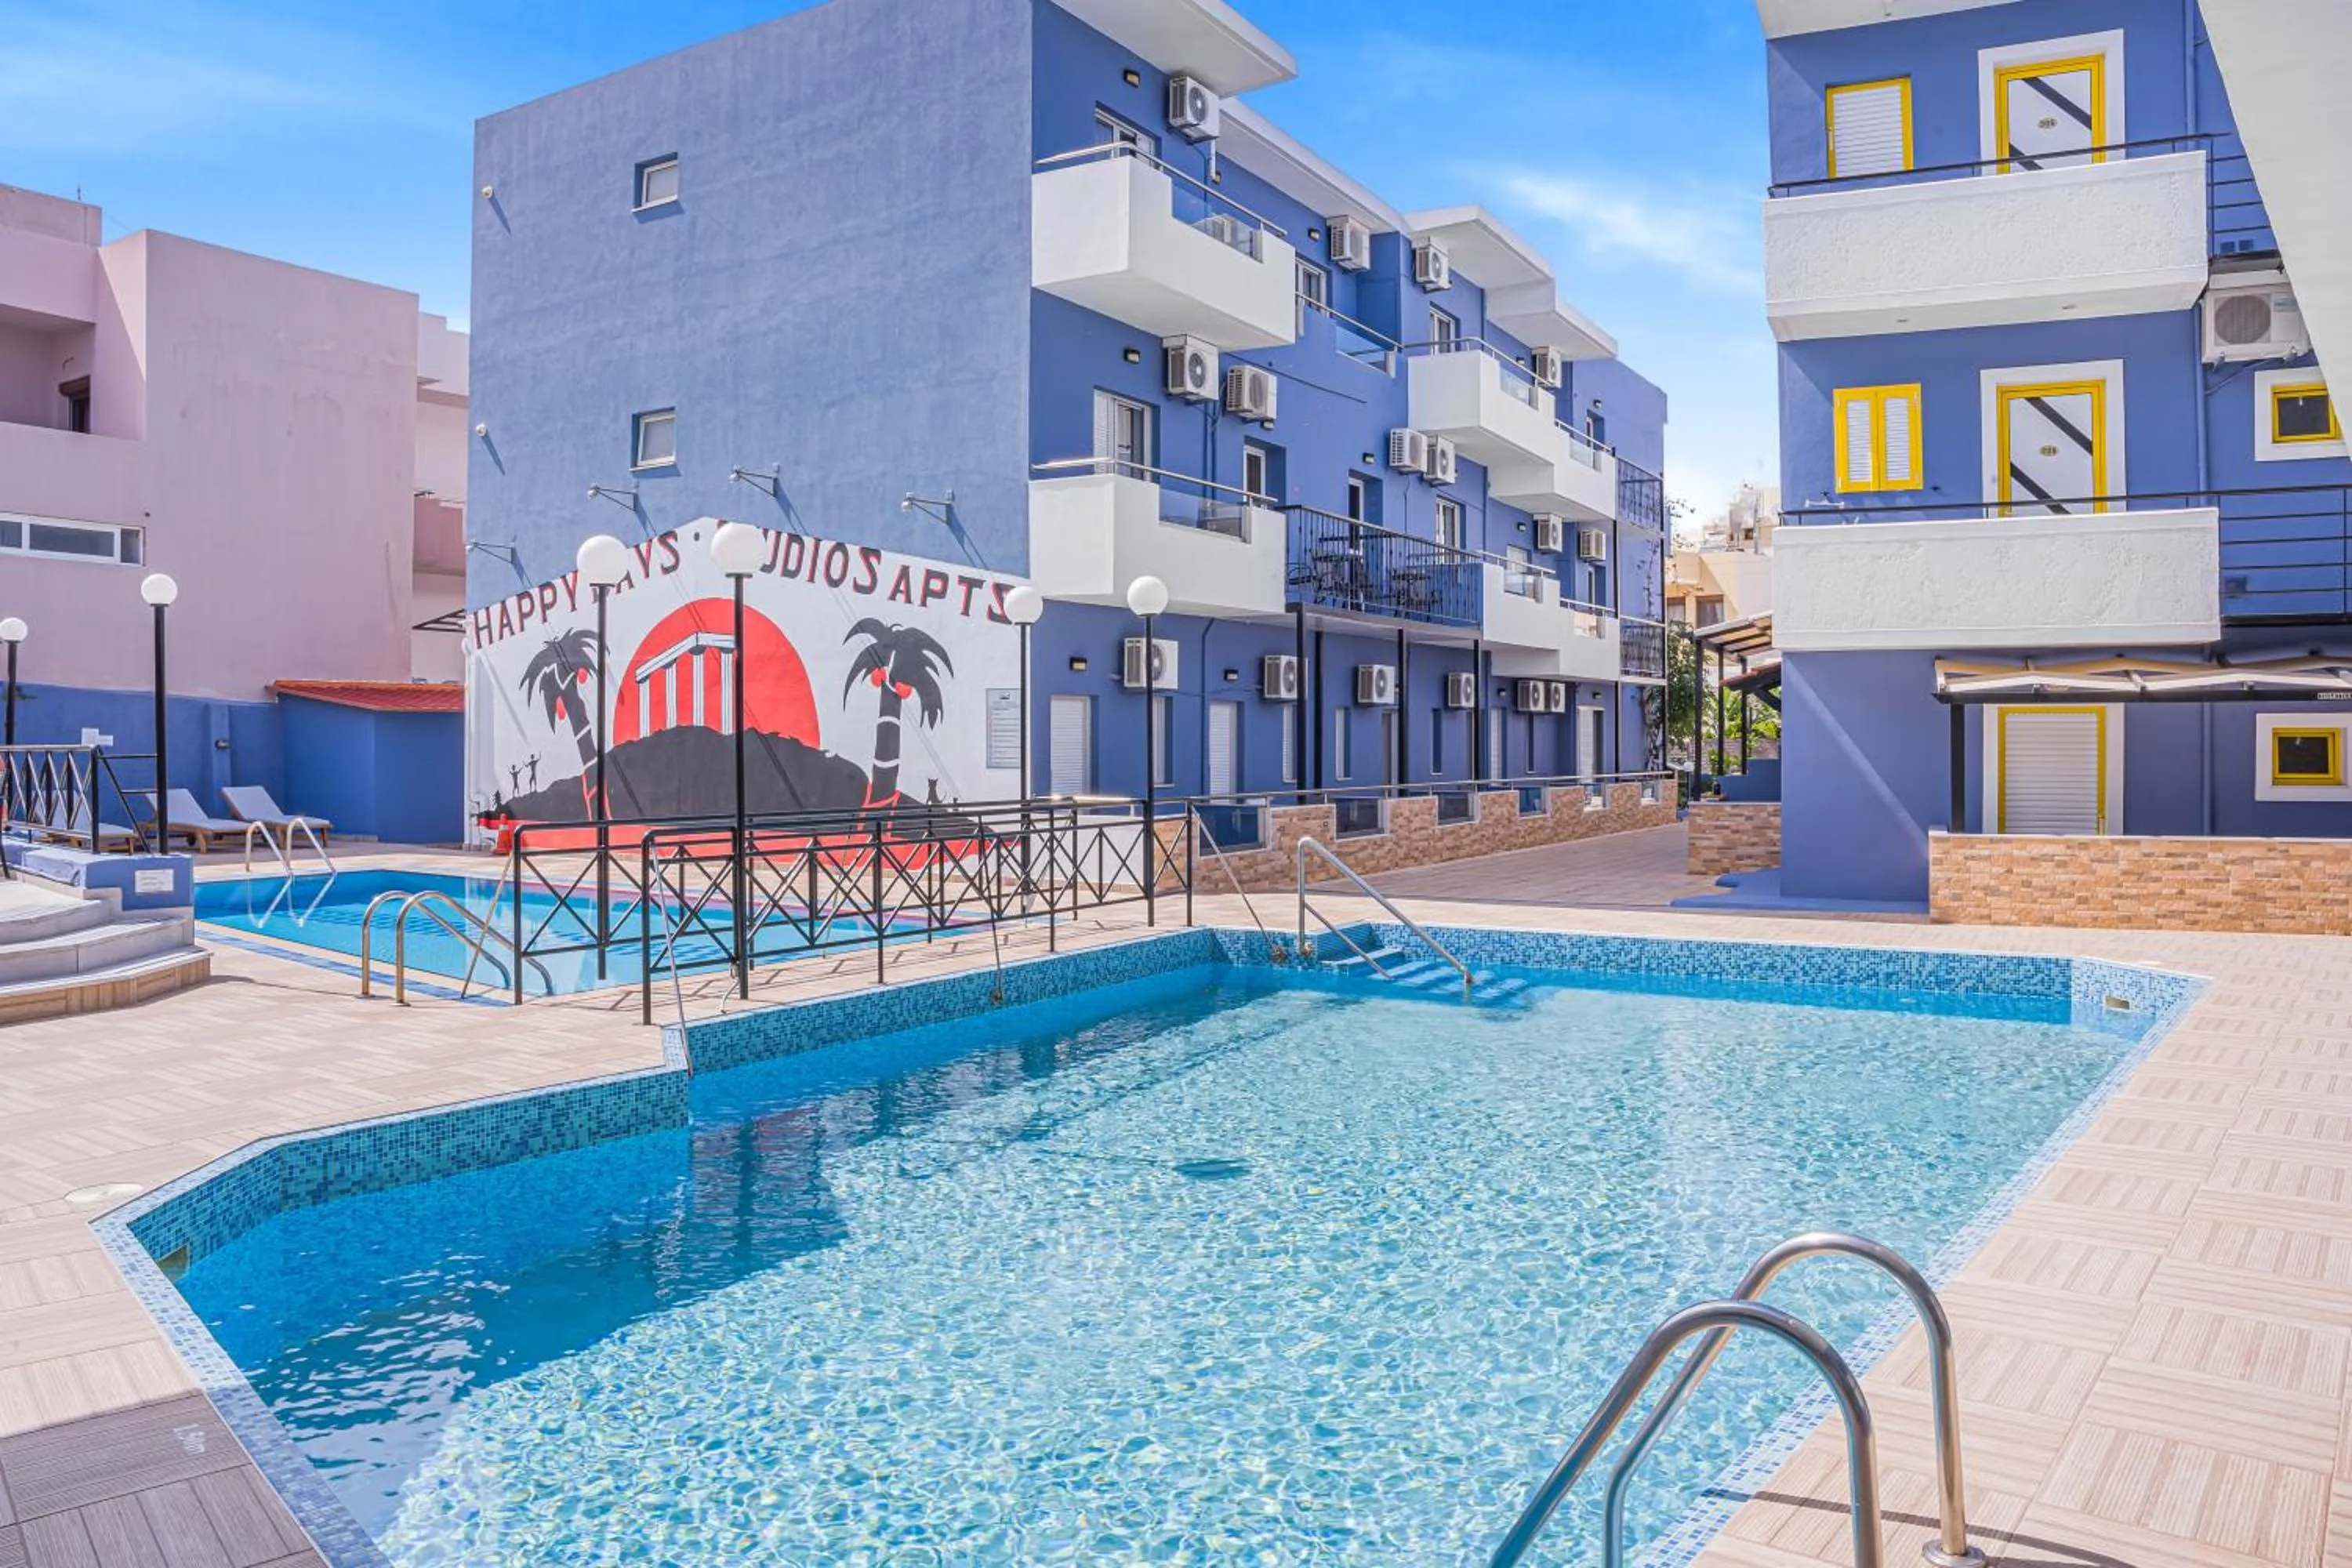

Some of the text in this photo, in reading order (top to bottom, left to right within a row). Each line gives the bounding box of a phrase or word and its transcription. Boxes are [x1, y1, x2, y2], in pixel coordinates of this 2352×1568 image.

[473, 570, 578, 649] HAPPY
[716, 519, 882, 595] UDIOS
[887, 564, 1017, 625] APTS
